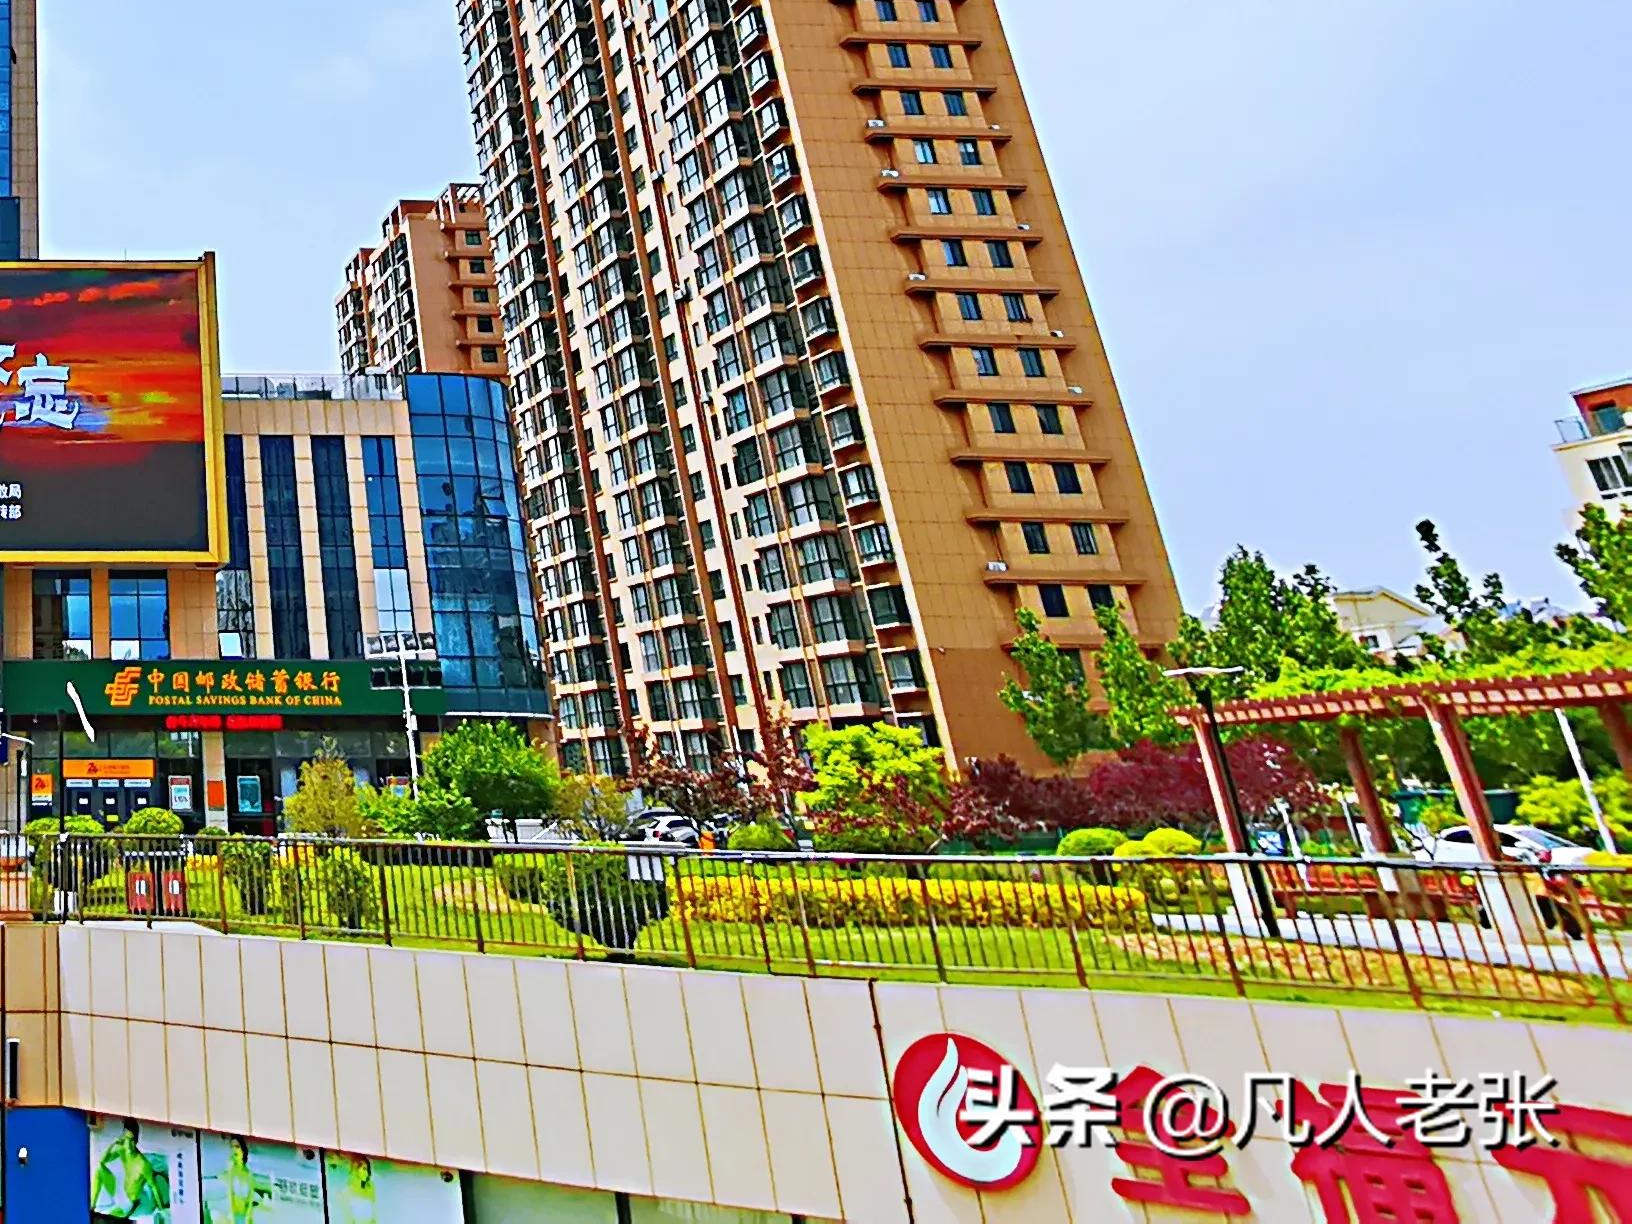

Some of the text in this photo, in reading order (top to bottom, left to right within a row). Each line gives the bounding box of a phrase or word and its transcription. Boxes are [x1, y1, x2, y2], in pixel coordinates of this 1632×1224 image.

[147, 667, 342, 694] 中国邮政储蓄银行
[148, 695, 342, 707] POSTAL SAVINGS BANK OF CHINA
